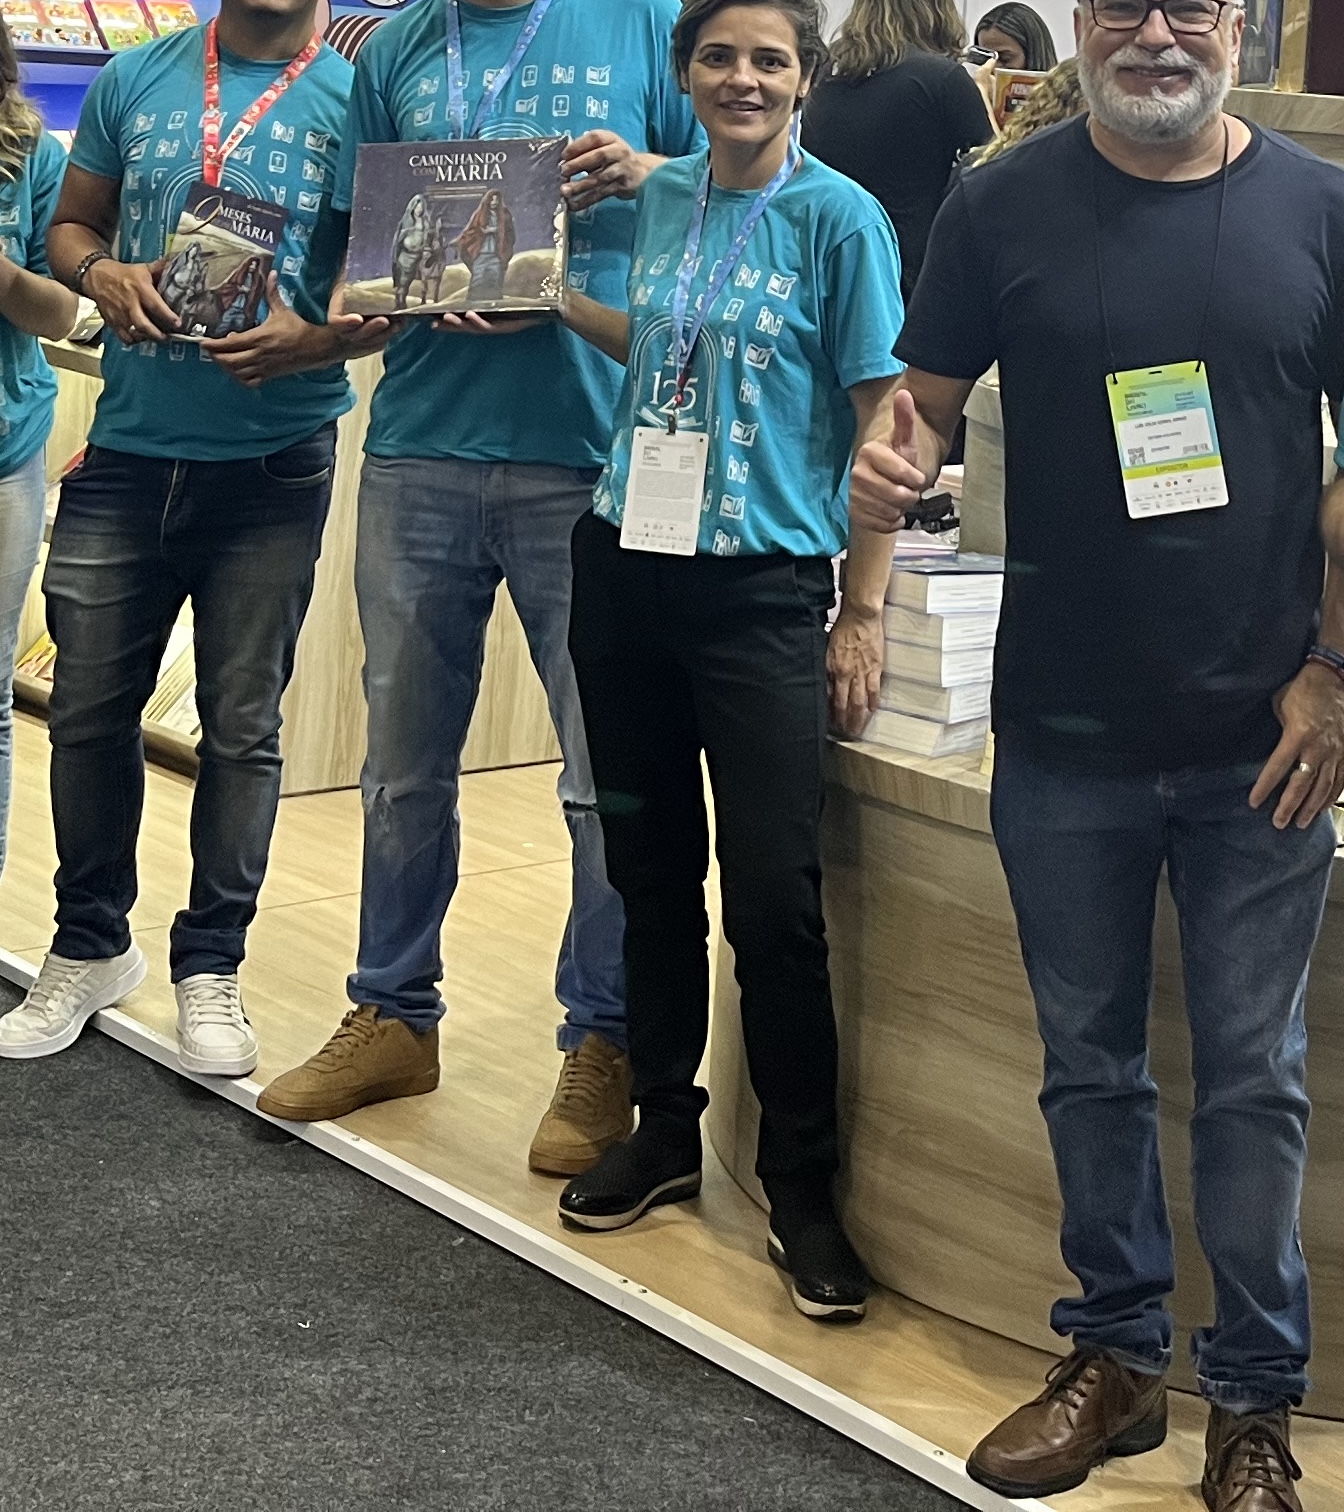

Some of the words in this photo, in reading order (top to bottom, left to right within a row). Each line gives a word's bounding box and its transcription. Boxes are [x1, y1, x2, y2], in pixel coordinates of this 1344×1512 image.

[408, 151, 508, 168] CAMINHANDO
[435, 163, 503, 183] MARIA
[217, 205, 253, 224] MESES
[229, 219, 275, 244] MARIA
